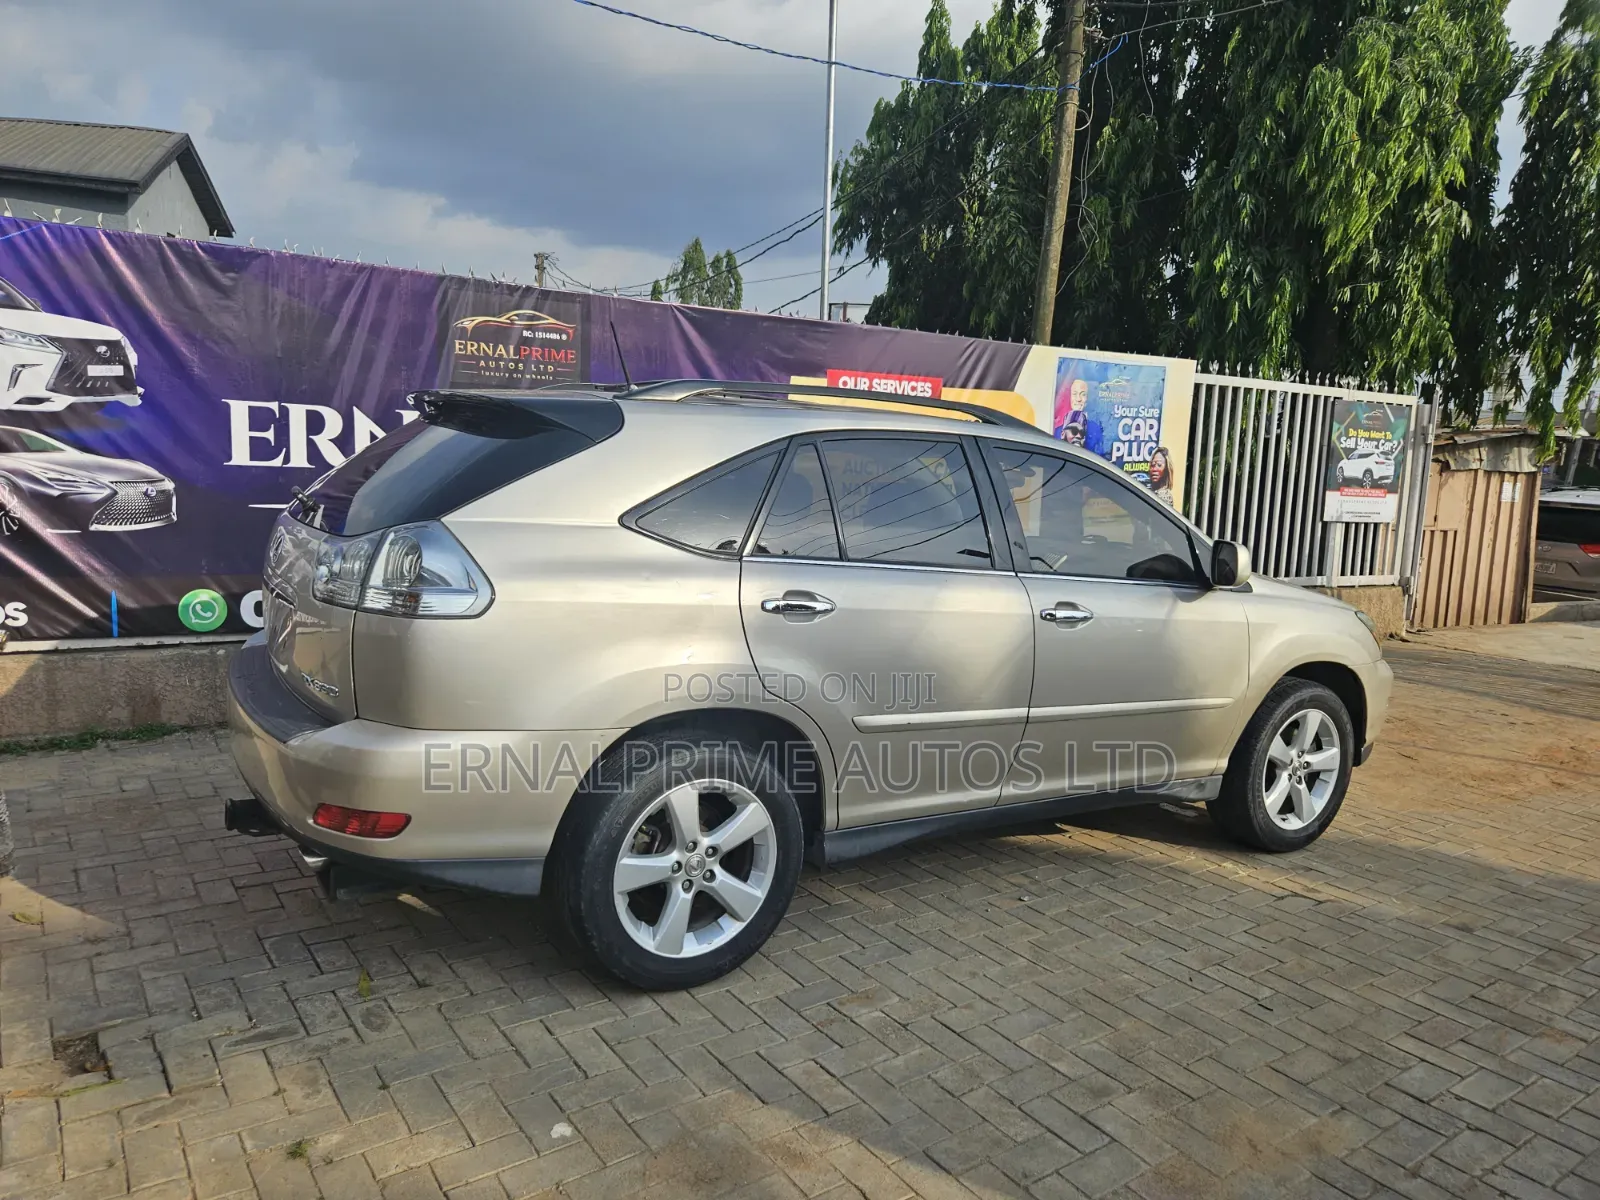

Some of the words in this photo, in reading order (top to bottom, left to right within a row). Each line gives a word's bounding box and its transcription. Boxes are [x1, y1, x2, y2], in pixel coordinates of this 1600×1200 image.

[454, 339, 577, 363] ERNALPRIME
[479, 360, 524, 371] AUTOS
[531, 363, 555, 372] LTD
[481, 370, 509, 379] luxury
[525, 373, 553, 381] wheels
[838, 375, 870, 390] OUR
[872, 378, 933, 398] SERVICES
[1114, 404, 1138, 418] Your
[1139, 405, 1160, 417] Sure
[1117, 418, 1158, 441] CAR
[1348, 428, 1357, 437] Do
[1358, 428, 1369, 438] You
[1370, 430, 1385, 439] Want
[1386, 431, 1392, 440] To
[1340, 436, 1356, 449] Sell
[1357, 437, 1378, 450] Your
[1378, 439, 1398, 452] Car?
